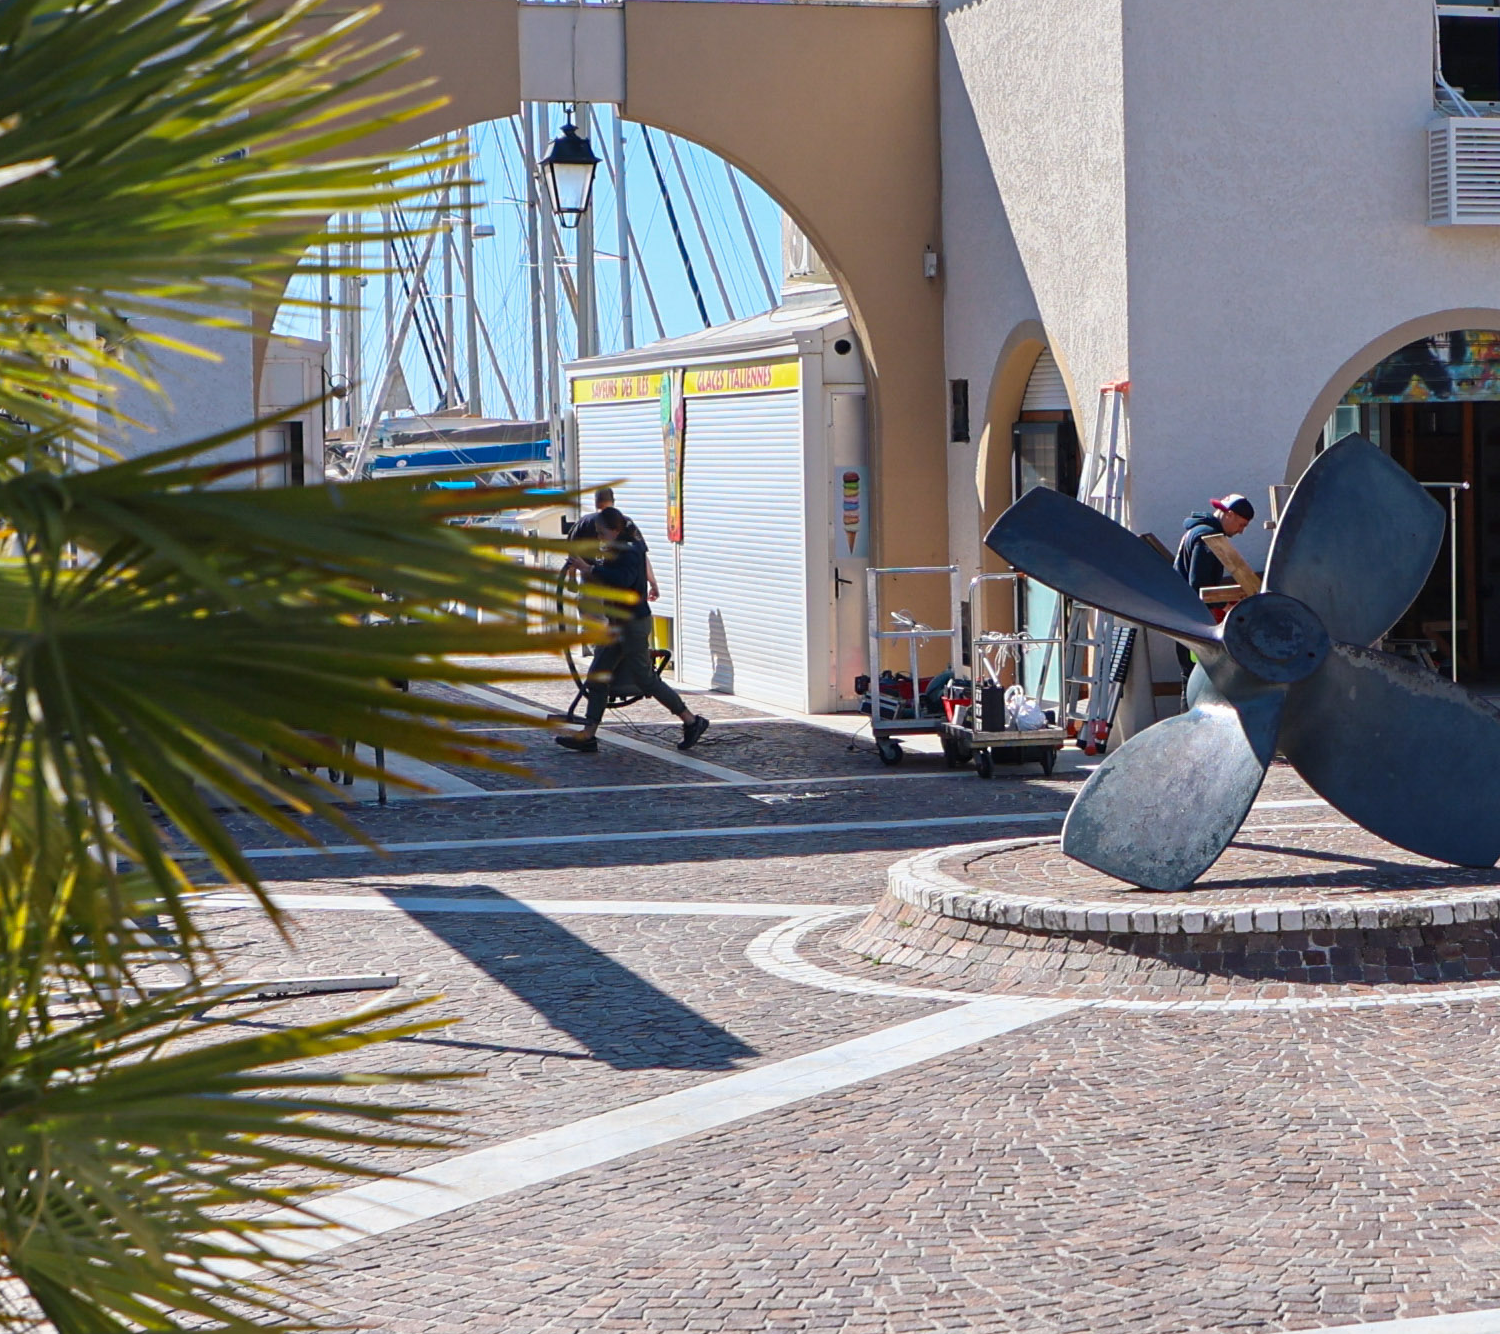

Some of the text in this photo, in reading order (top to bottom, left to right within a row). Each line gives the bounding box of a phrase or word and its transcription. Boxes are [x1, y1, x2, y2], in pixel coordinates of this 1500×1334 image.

[621, 377, 633, 397] DES
[697, 364, 772, 392] GLACES ITALIENNES
